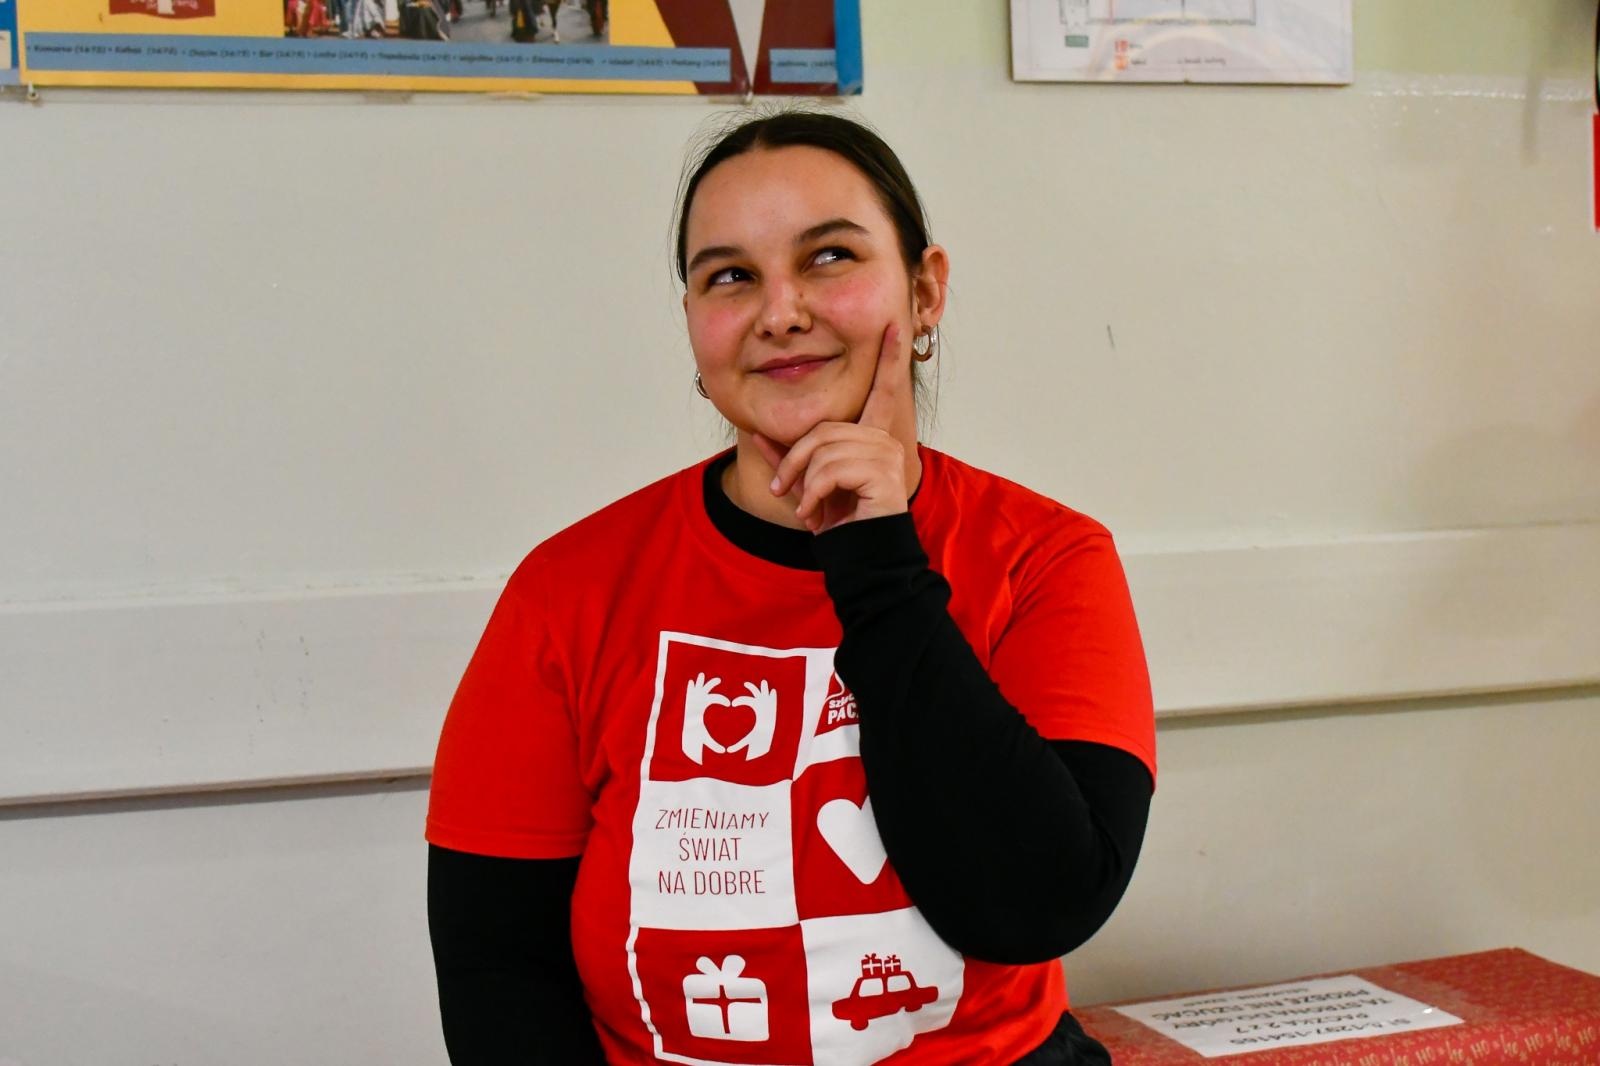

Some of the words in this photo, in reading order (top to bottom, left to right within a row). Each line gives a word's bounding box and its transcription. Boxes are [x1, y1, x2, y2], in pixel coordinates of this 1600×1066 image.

[827, 702, 859, 725] PAC
[655, 808, 769, 830] ZMIENIAMY
[679, 832, 741, 861] ŚWIAT
[658, 870, 686, 895] NA
[694, 869, 766, 895] DOBRE
[1283, 1012, 1369, 1027] PACZKA
